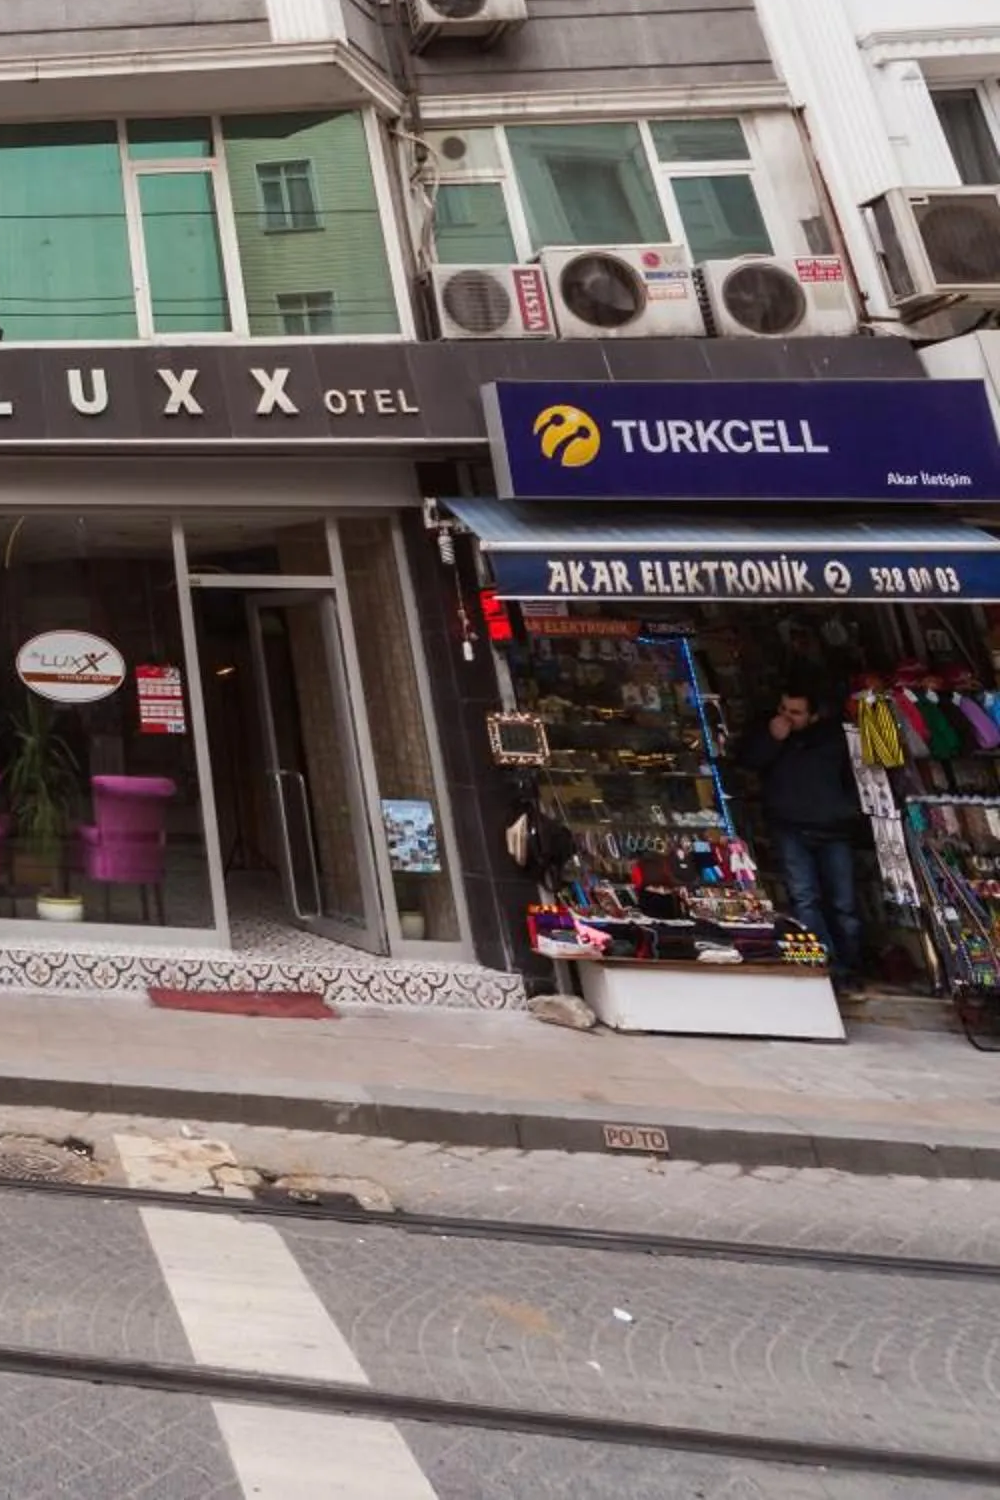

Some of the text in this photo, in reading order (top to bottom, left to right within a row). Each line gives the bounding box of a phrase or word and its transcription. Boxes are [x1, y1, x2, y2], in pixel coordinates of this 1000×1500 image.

[519, 270, 545, 330] VESTEL
[323, 389, 420, 414] OTEL
[611, 419, 829, 453] TURKCELL
[887, 471, 919, 485] Akar
[547, 560, 633, 593] AKAR
[869, 567, 906, 593] 528
[934, 567, 961, 593] 03
